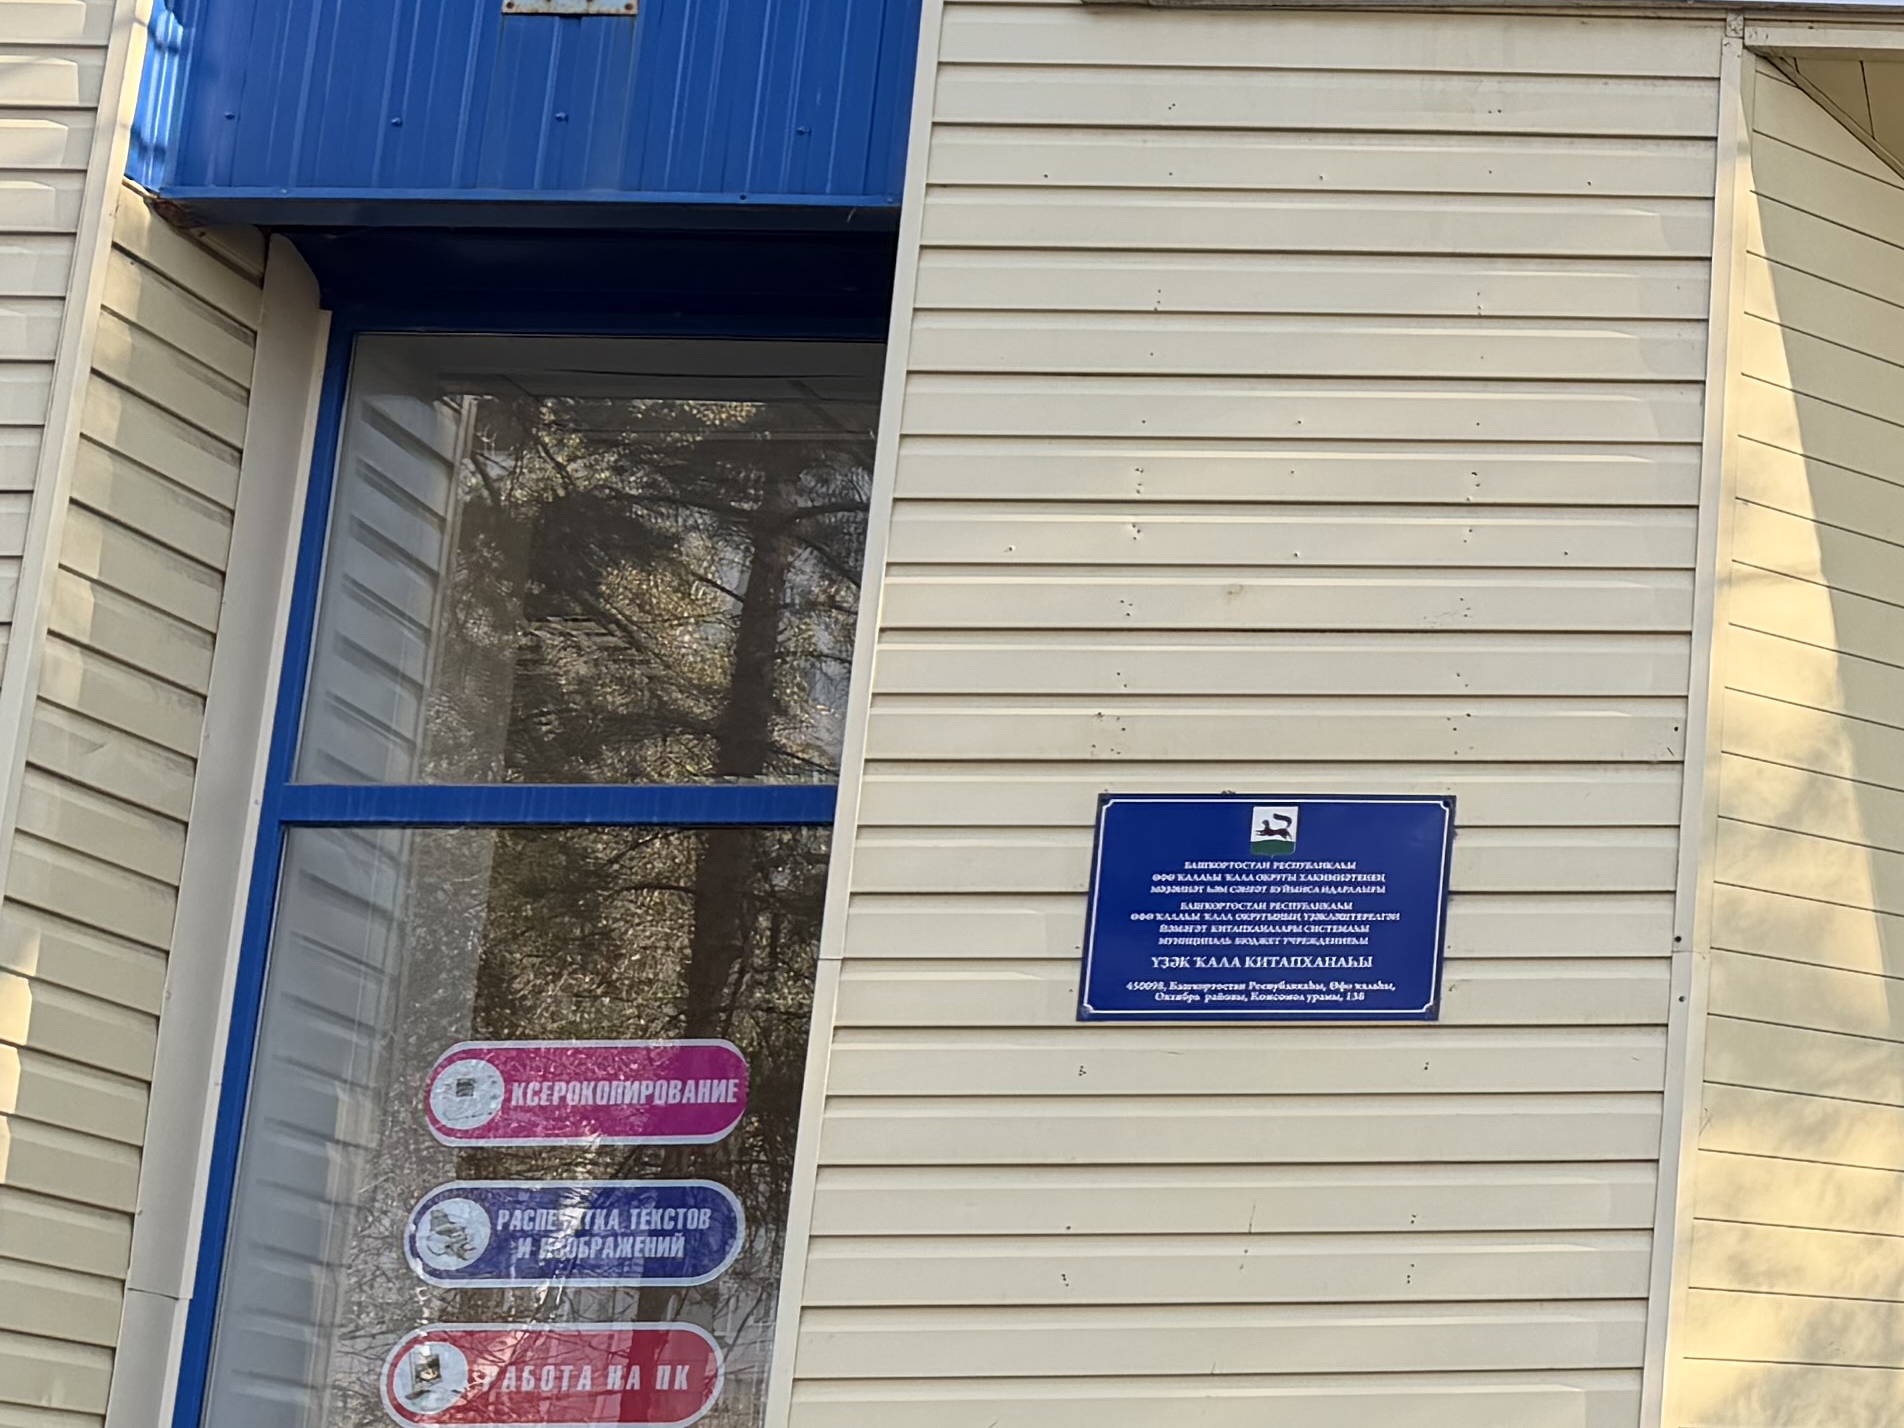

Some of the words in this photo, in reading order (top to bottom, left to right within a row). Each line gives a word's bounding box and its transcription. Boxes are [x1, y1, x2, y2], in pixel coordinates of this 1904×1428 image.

[1193, 956, 1242, 969] ҠАЛА
[1244, 956, 1373, 969] КИТАПХАНАҺЫ
[511, 1079, 740, 1106] КСЕРОКОПИРОВАНИЕ
[497, 1208, 620, 1231] РАСПЕТКА
[630, 1208, 712, 1230] ТЕКСТОВ
[517, 1236, 532, 1259] И
[607, 1365, 641, 1390] НА
[655, 1365, 690, 1390] ПК
